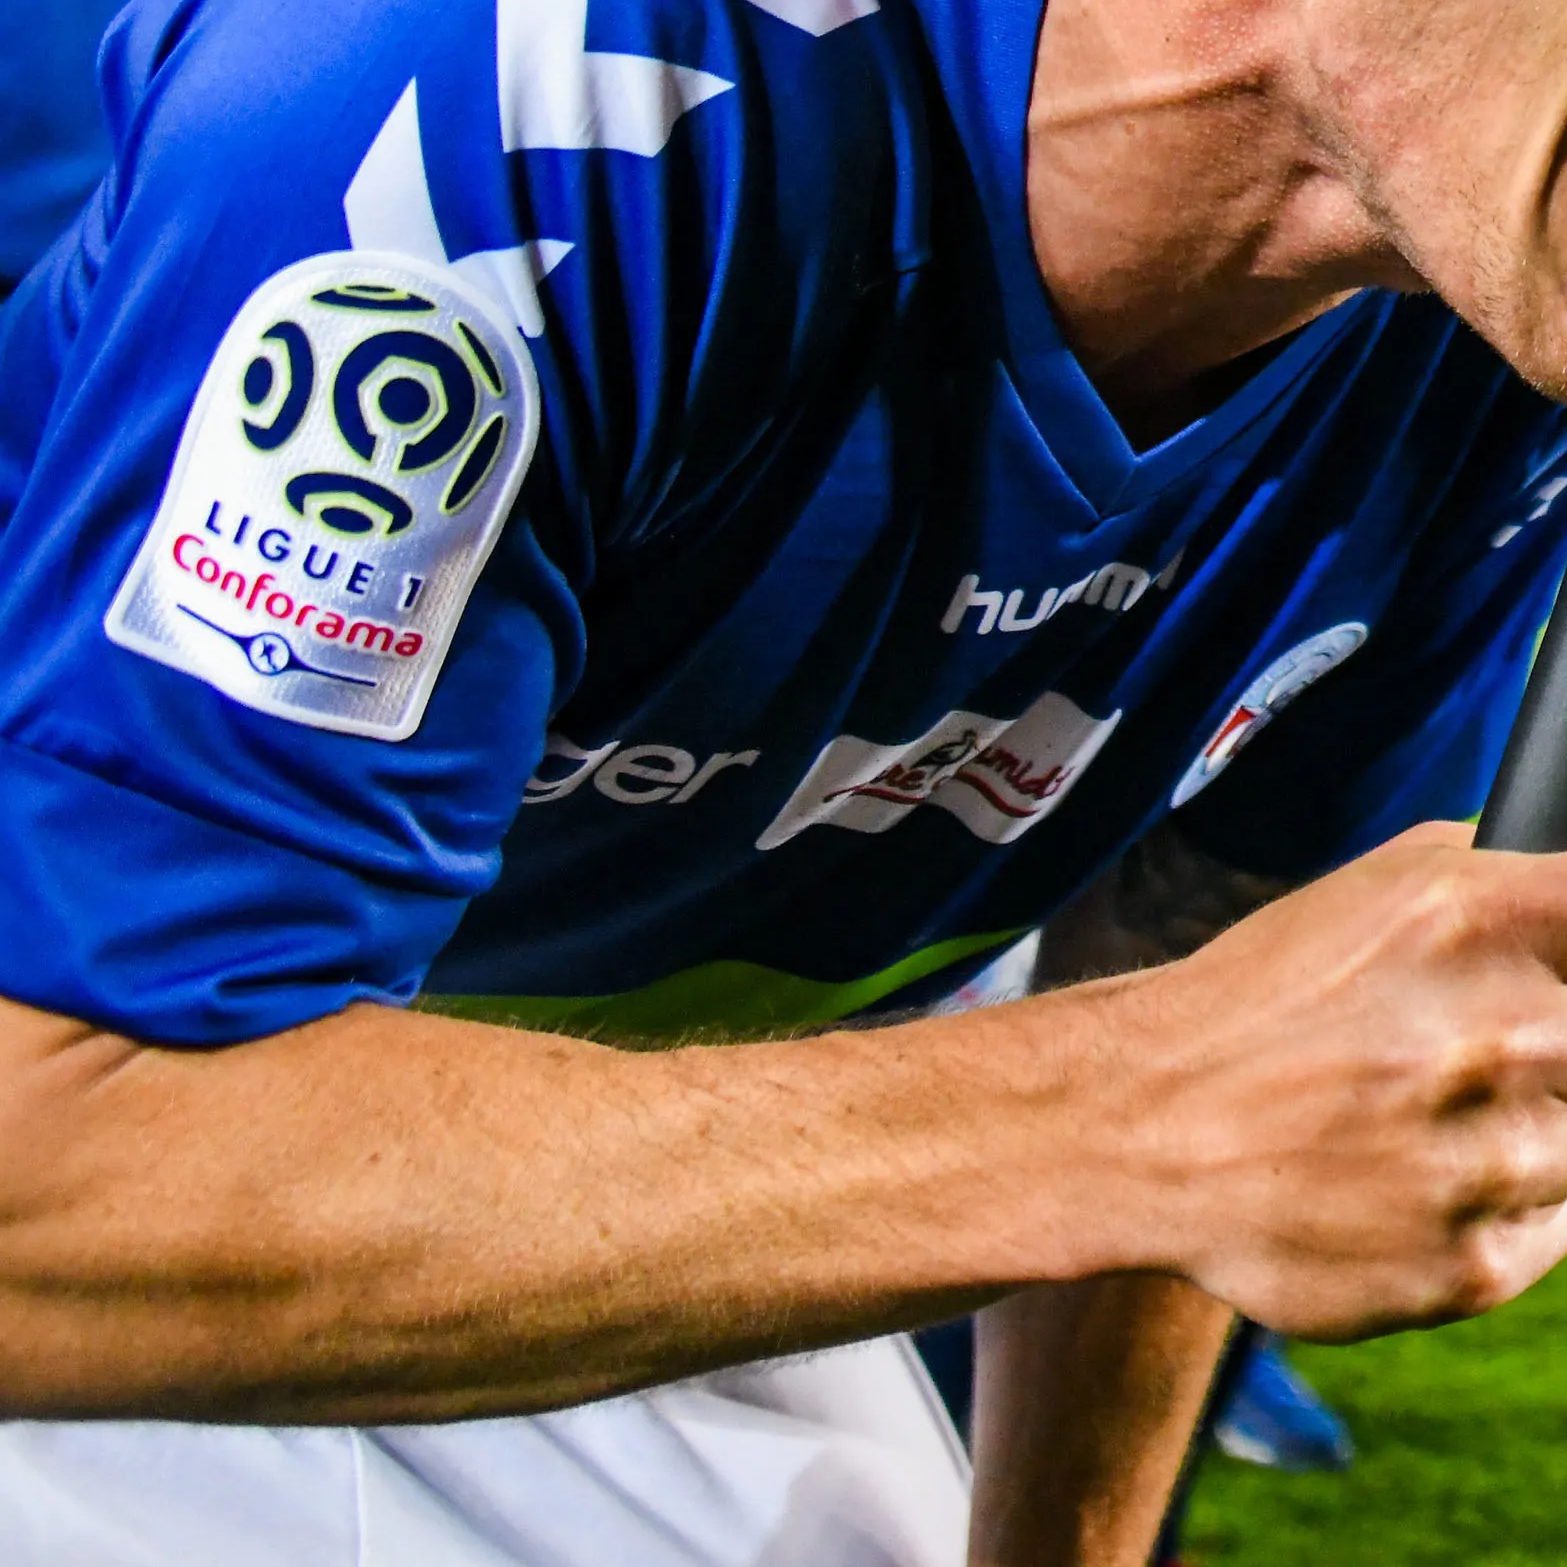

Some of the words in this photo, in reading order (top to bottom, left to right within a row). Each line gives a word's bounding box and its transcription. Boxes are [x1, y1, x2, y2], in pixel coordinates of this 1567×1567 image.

[171, 533, 425, 659] Conforama
[204, 500, 375, 596] LIGUE
[402, 575, 423, 610] 1
